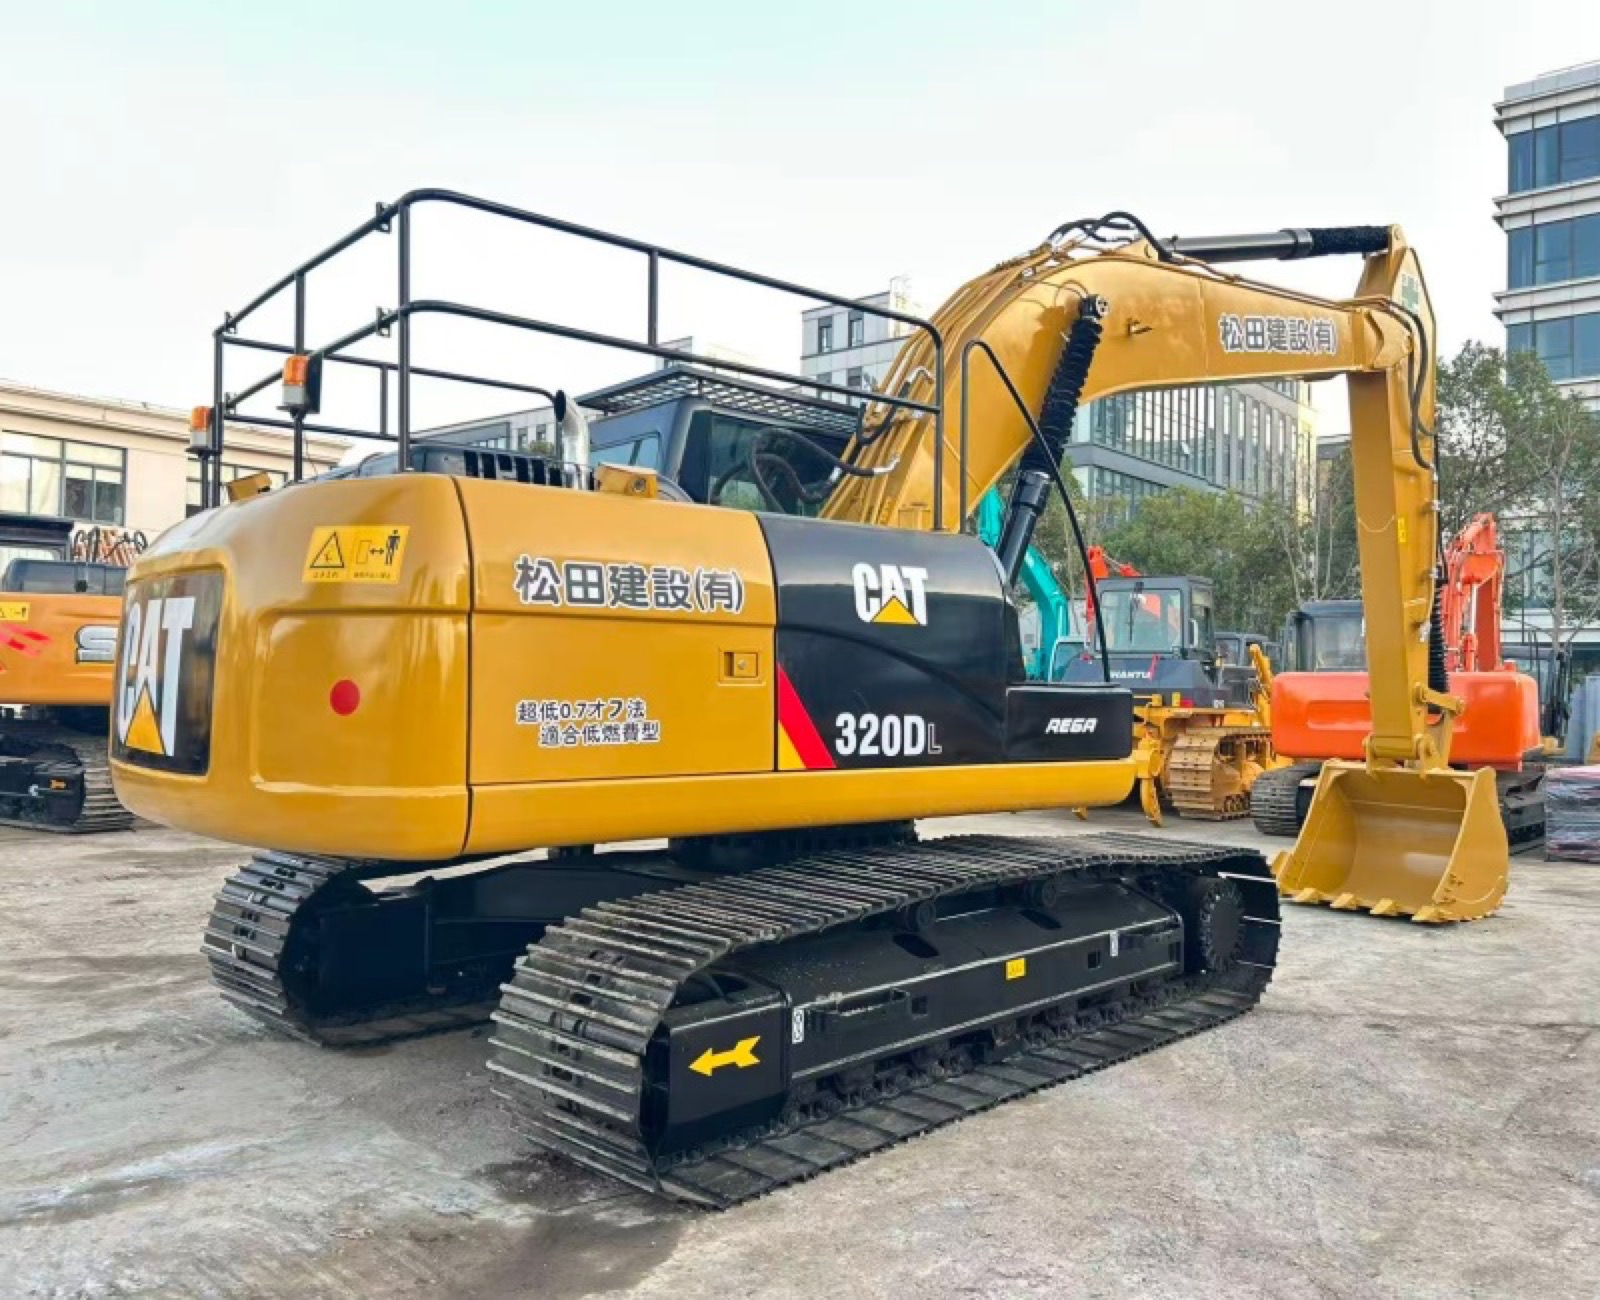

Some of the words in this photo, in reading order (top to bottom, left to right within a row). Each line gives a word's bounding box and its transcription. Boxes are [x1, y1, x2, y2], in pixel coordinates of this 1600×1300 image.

[1218, 312, 1338, 354] 松田建設(有)
[514, 554, 744, 612] 松田建設(有)
[852, 562, 928, 626] CAT
[117, 597, 196, 757] CAT
